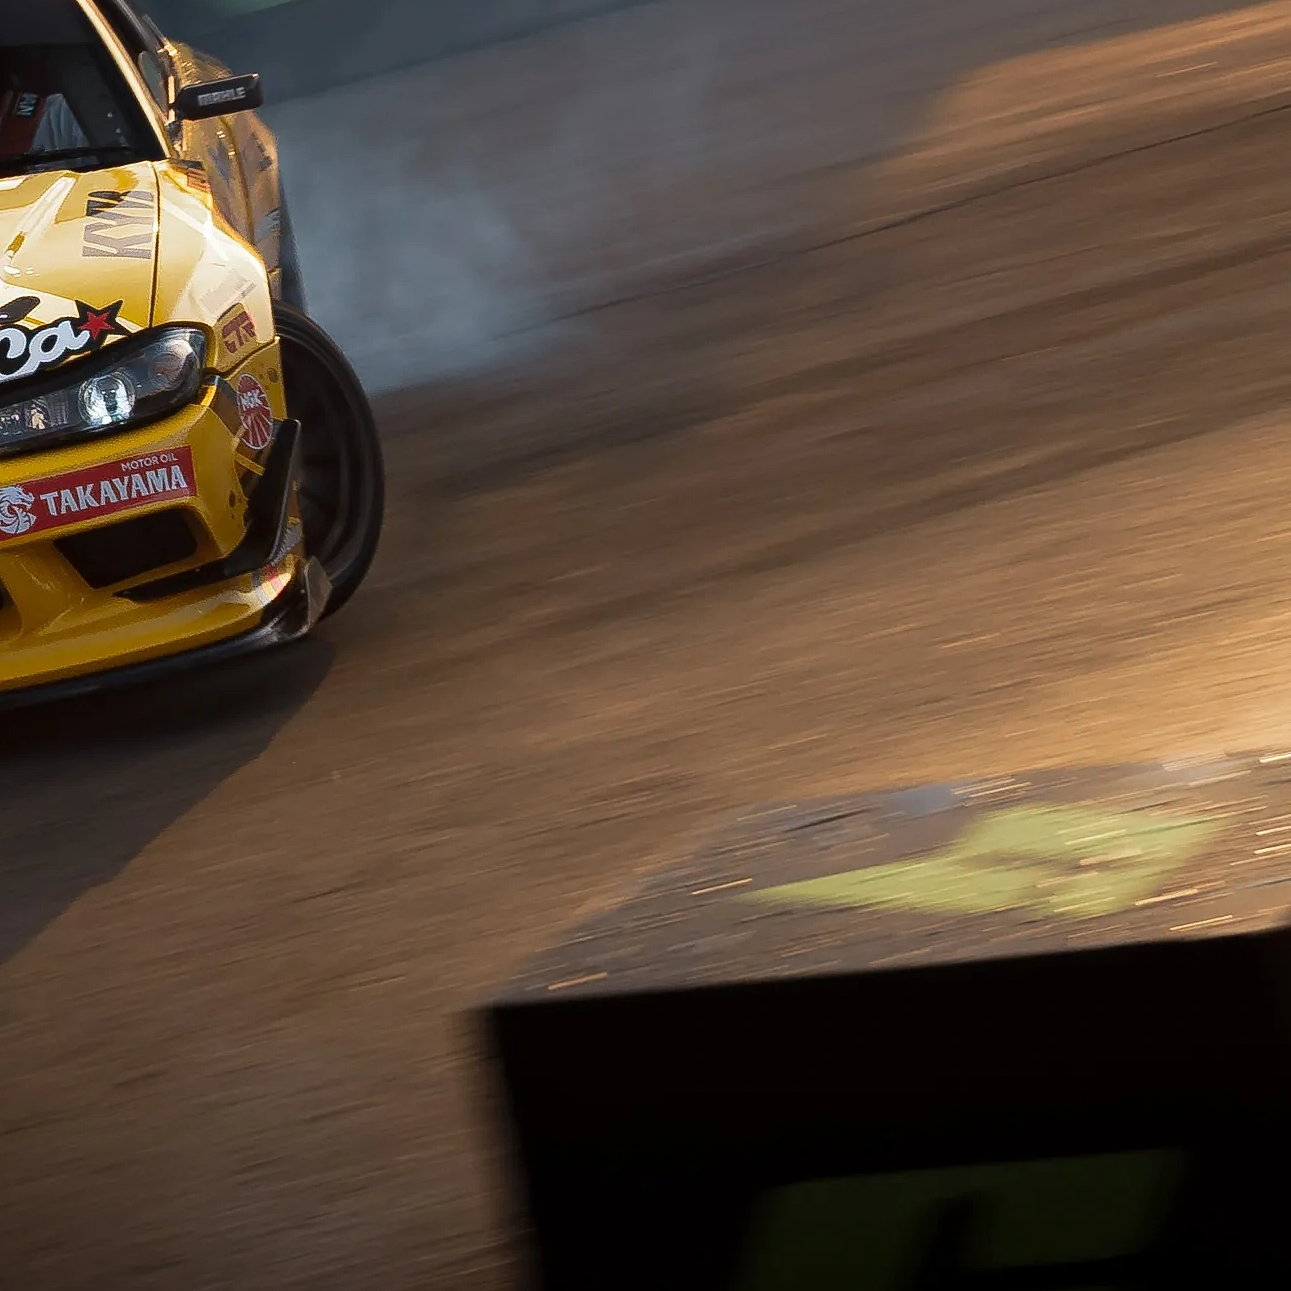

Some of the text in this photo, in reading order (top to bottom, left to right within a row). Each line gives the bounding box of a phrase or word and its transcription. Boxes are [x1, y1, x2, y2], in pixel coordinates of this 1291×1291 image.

[121, 452, 179, 473] MOTOR OIL
[39, 464, 188, 517] TAKAYAMA
